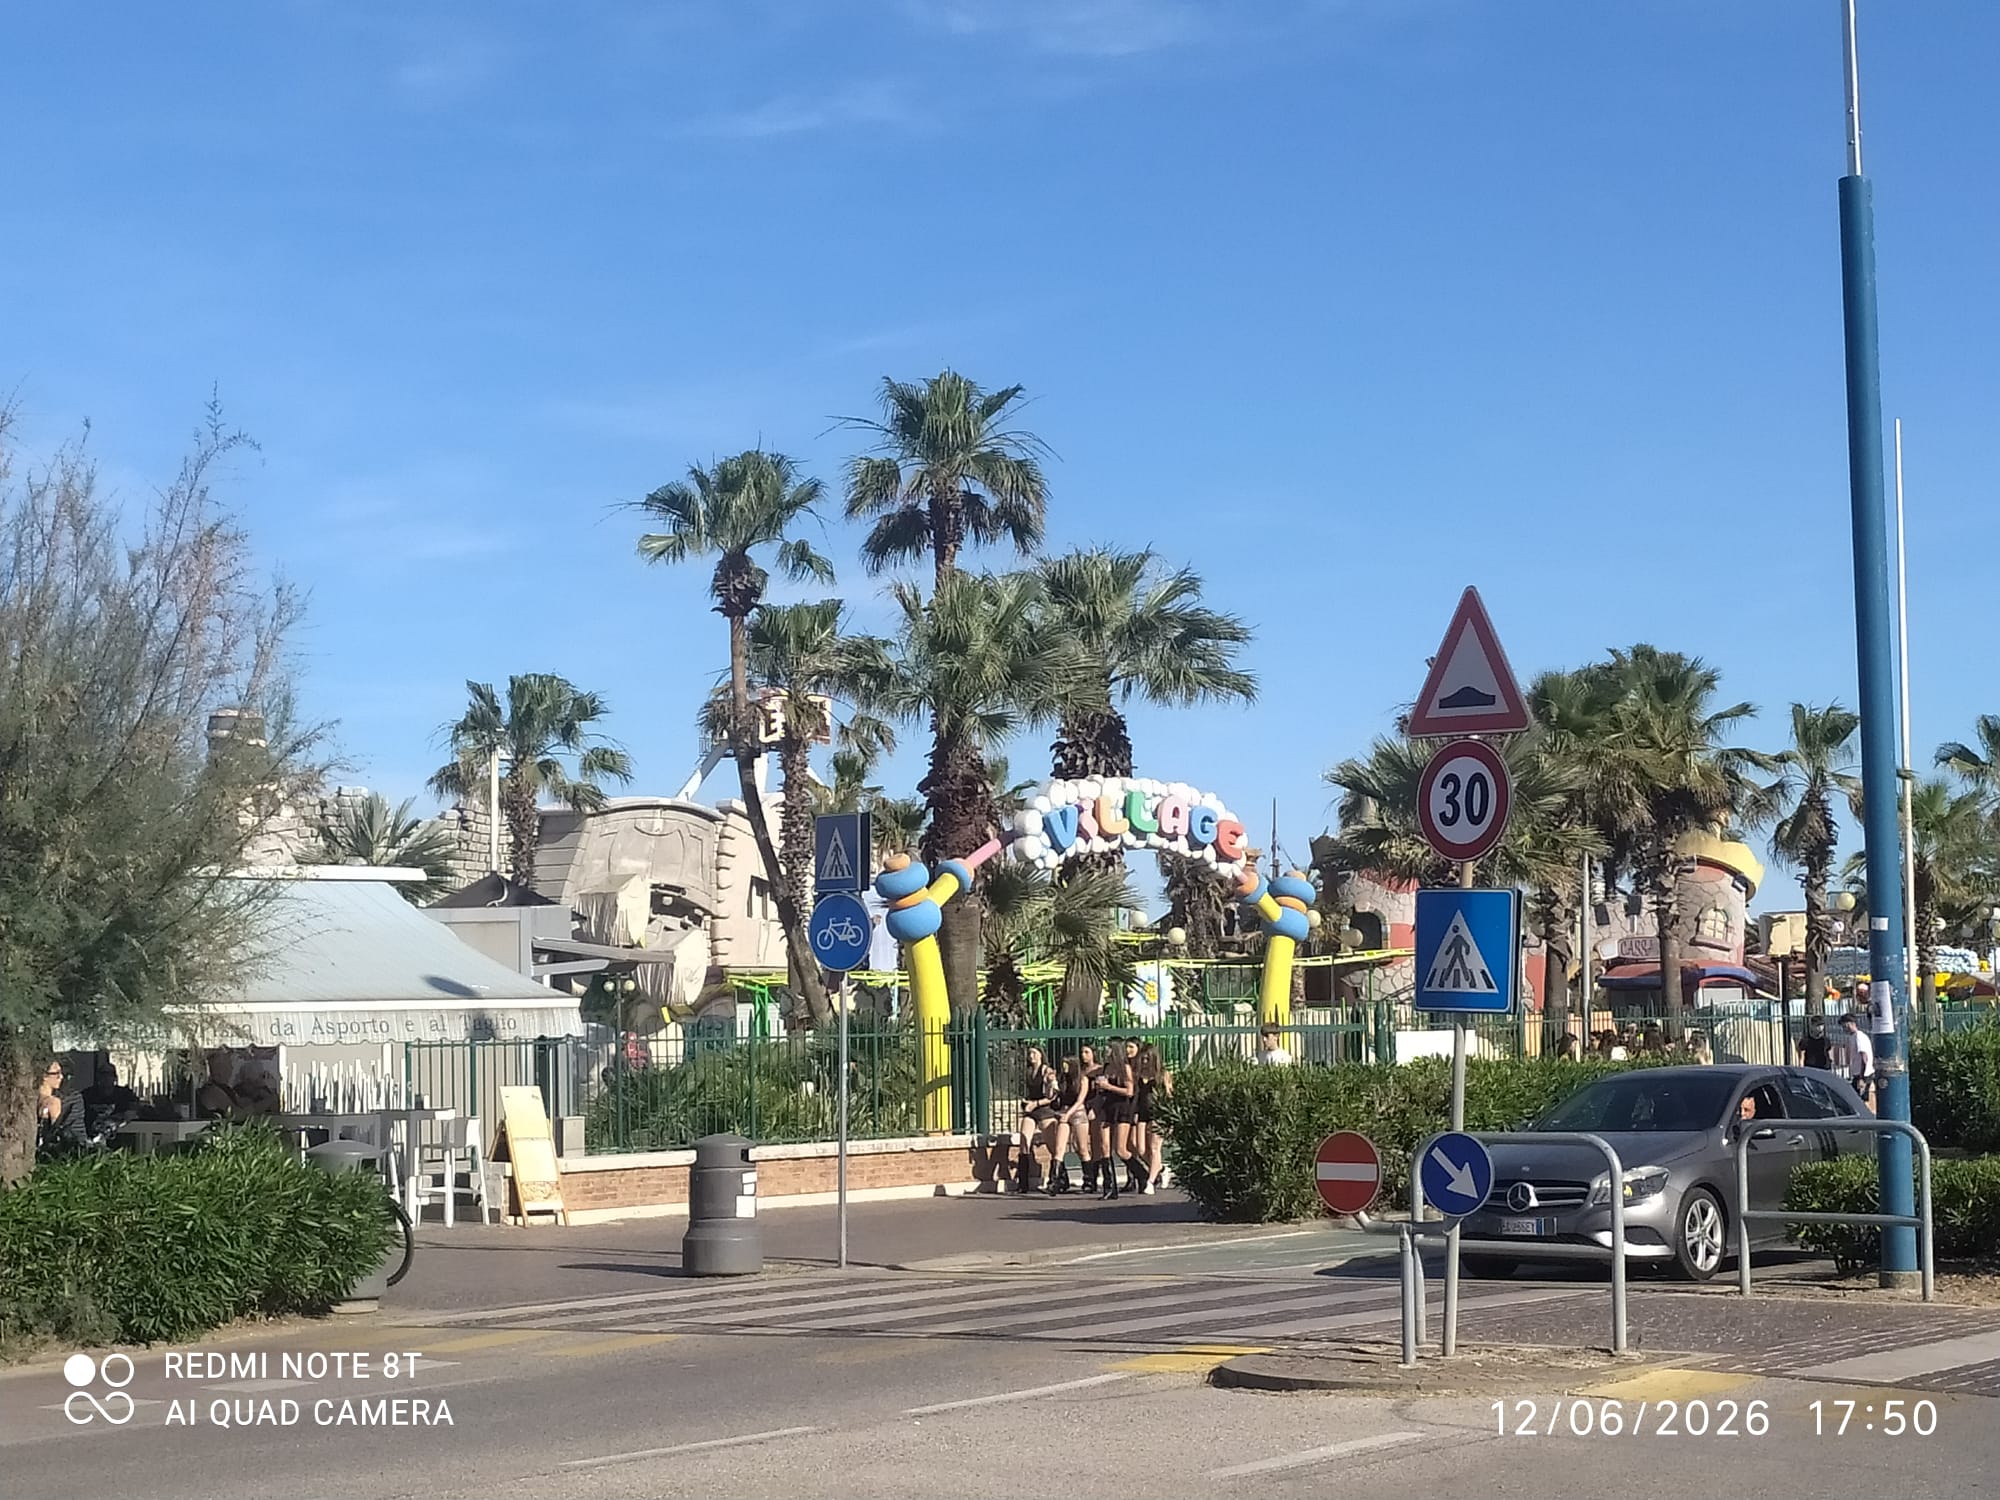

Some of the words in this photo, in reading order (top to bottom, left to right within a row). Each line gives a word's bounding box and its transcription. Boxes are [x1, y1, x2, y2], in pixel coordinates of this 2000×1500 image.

[1438, 771, 1490, 827] 30
[269, 1016, 295, 1037] da
[310, 1015, 390, 1040] Asporto
[404, 1019, 415, 1033] e
[429, 1014, 448, 1033] al
[458, 1012, 517, 1037] Taglio
